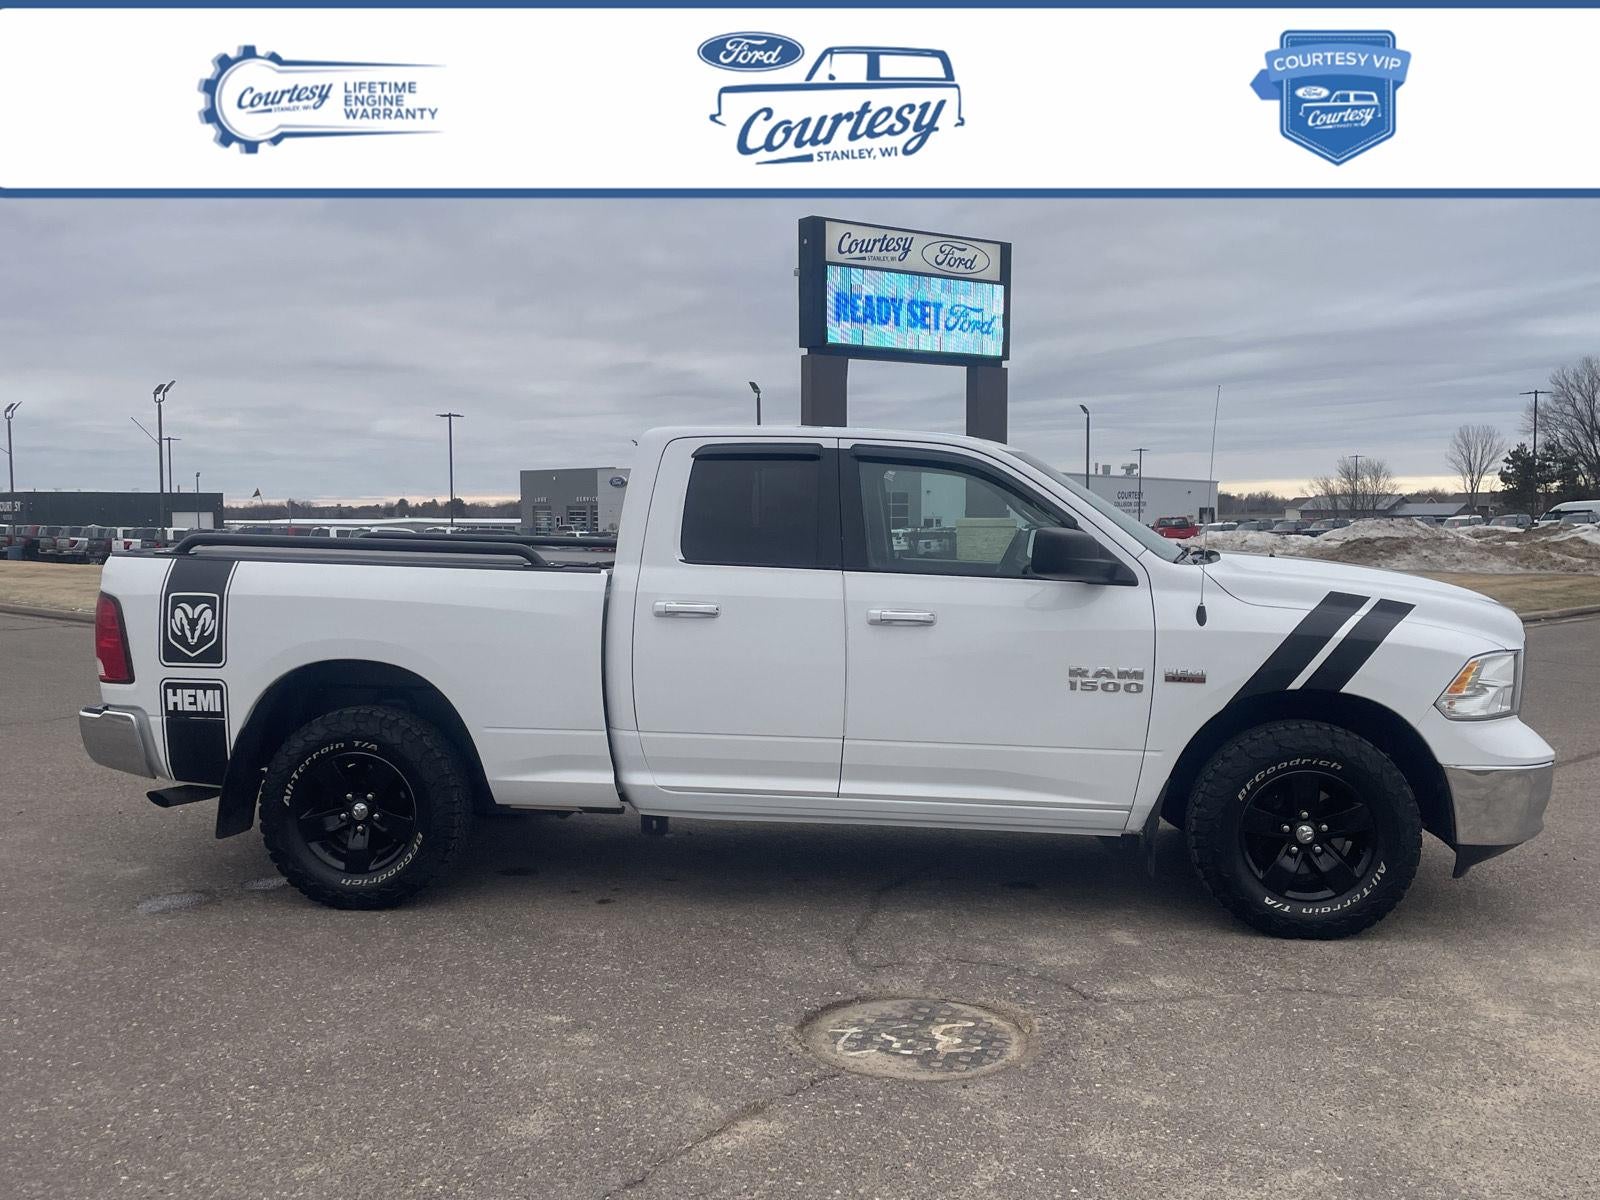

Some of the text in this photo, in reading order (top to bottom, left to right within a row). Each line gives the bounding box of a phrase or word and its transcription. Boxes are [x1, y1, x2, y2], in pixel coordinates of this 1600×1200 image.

[837, 231, 914, 262] Courtesy
[934, 243, 977, 271] Ford
[834, 291, 997, 335] READY SET Ford
[1068, 665, 1144, 680] RAM
[1068, 680, 1144, 693] 1500
[166, 688, 222, 712] HEMI
[352, 740, 378, 751] T/A
